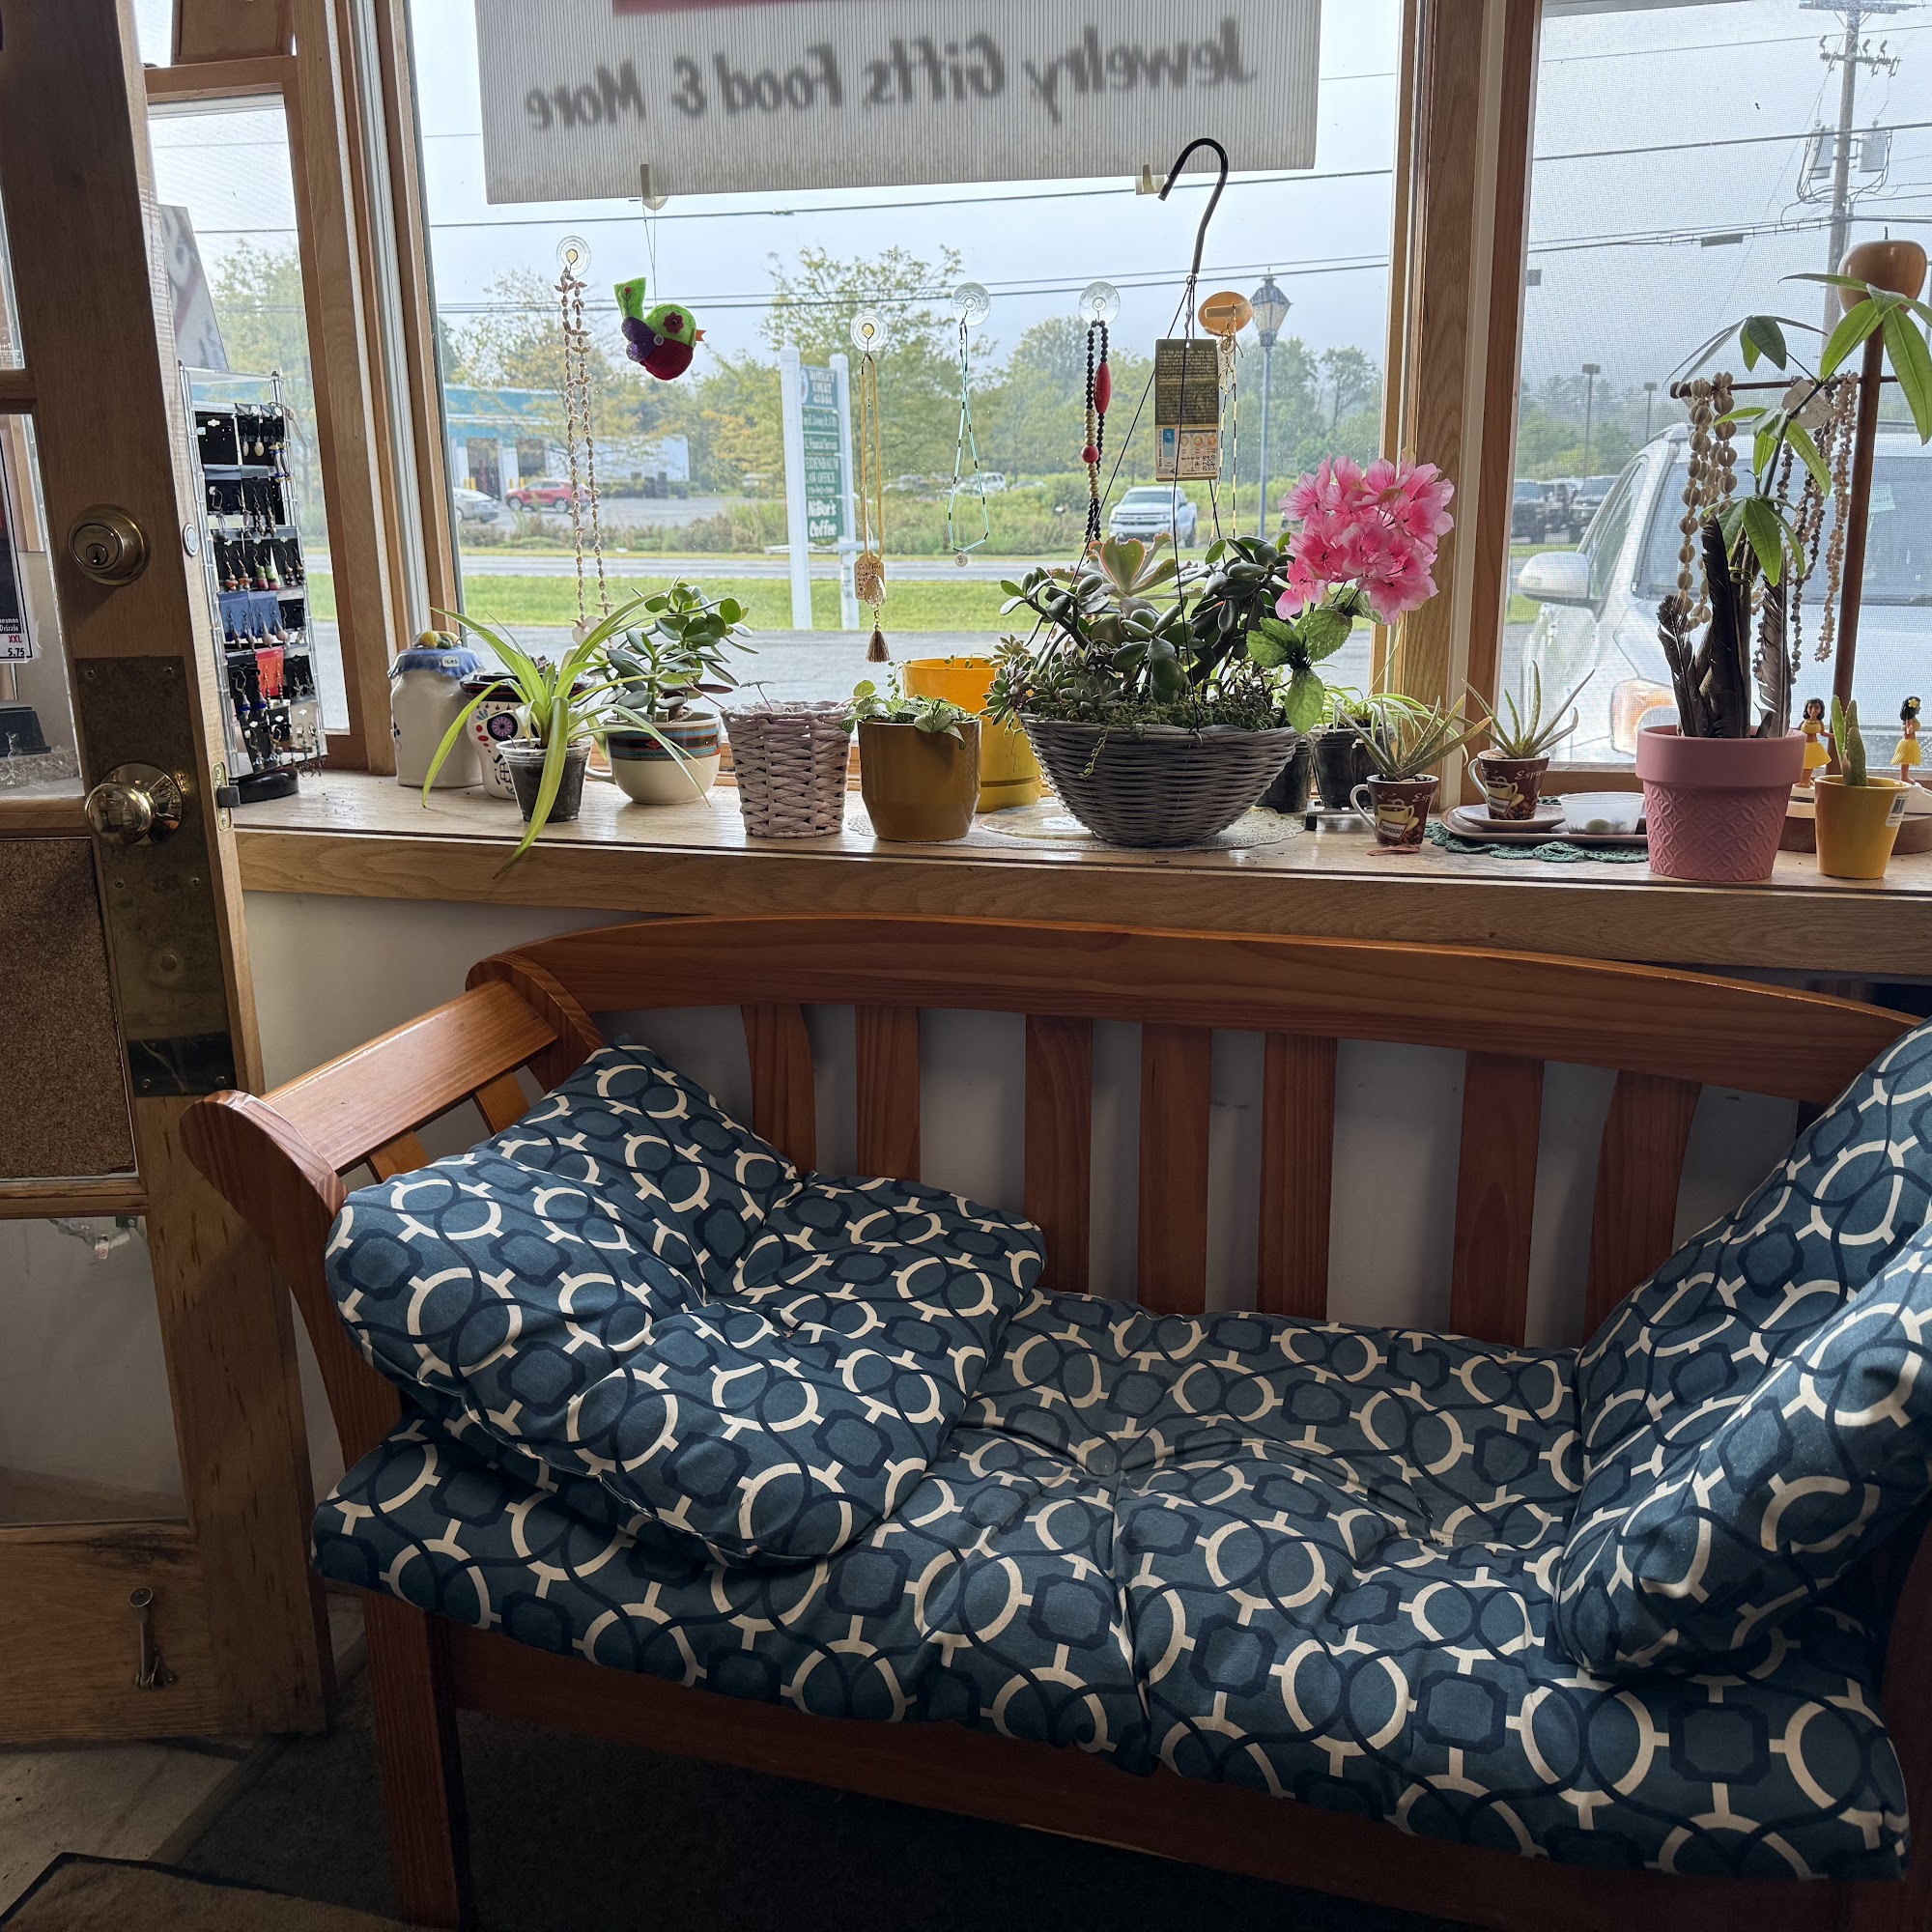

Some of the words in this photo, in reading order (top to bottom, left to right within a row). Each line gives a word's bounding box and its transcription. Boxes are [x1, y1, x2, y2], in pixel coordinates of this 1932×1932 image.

[809, 520, 838, 537] Coffee
[8, 634, 22, 643] XXL
[8, 647, 25, 657] 5.75
[1379, 822, 1405, 835] Espresso
